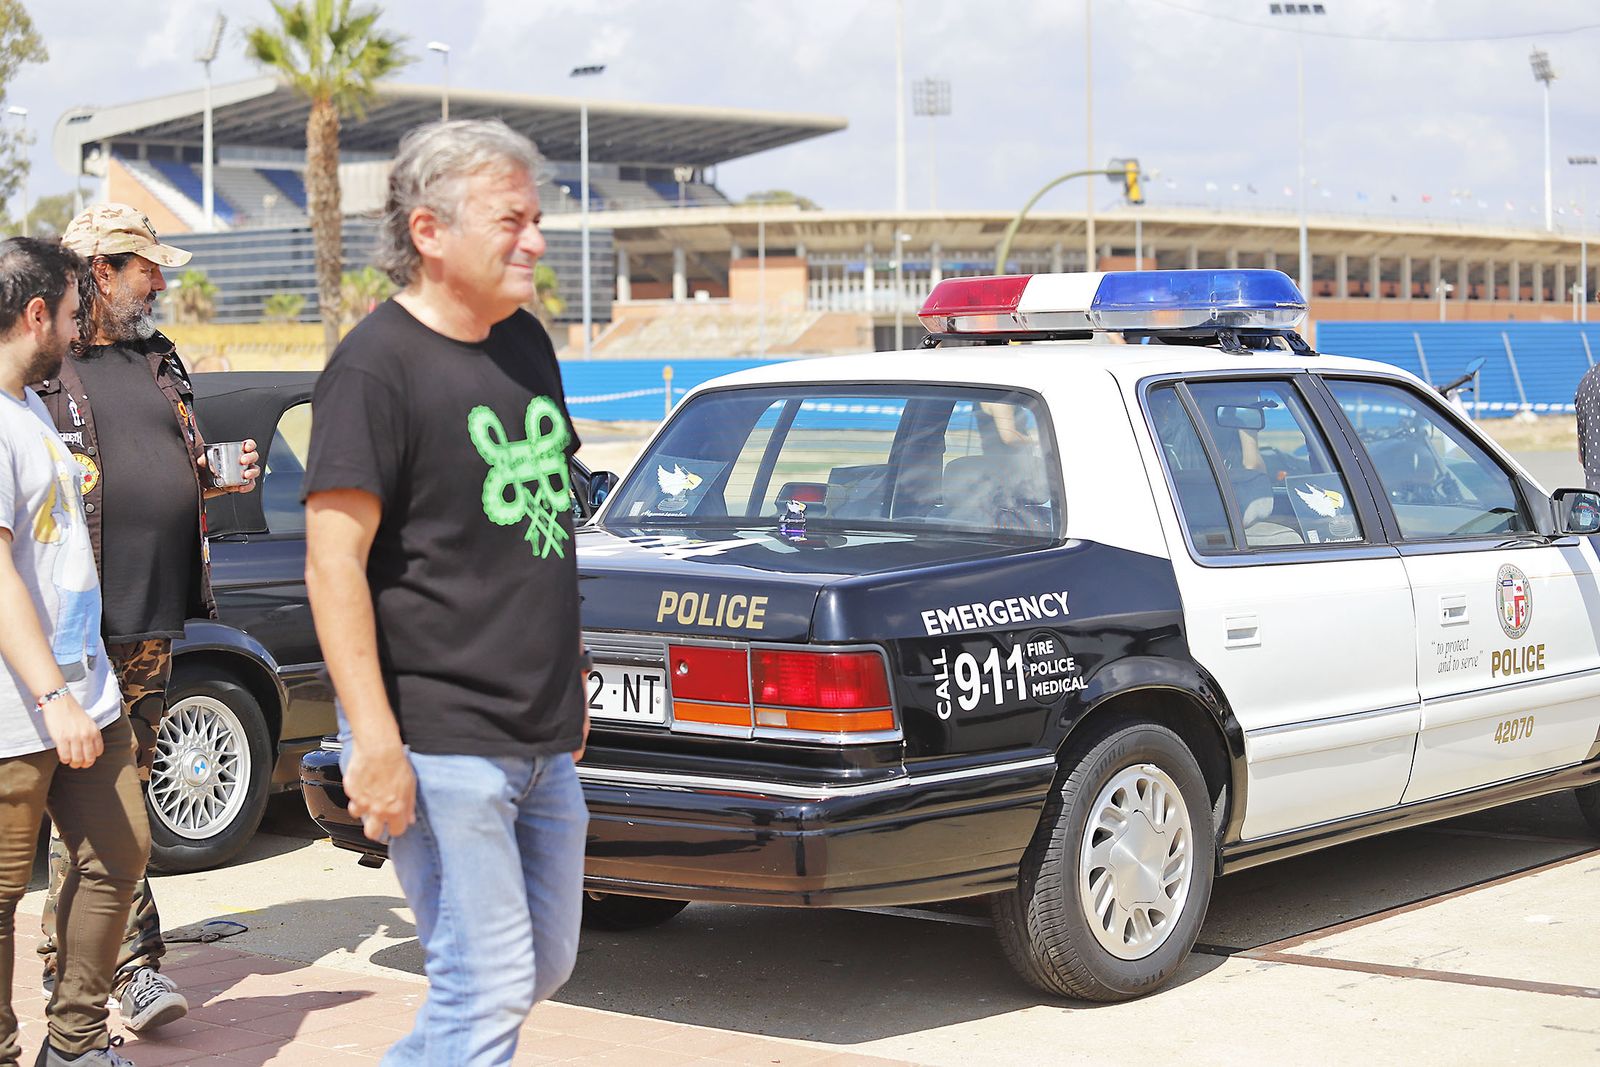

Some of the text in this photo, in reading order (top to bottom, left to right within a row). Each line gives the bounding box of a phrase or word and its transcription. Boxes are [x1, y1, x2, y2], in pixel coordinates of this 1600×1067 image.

[656, 590, 769, 630] POLICE
[921, 591, 1070, 635] EMERGENCY
[1026, 640, 1054, 657] FIRE
[1445, 638, 1470, 659] protect
[1491, 643, 1545, 678] POLICE
[1030, 657, 1076, 677] POLICE
[1437, 655, 1452, 674] and
[1452, 659, 1460, 671] to
[932, 648, 952, 720] CALL
[1032, 675, 1089, 697] MEDICAL
[1494, 715, 1535, 744] 42070
